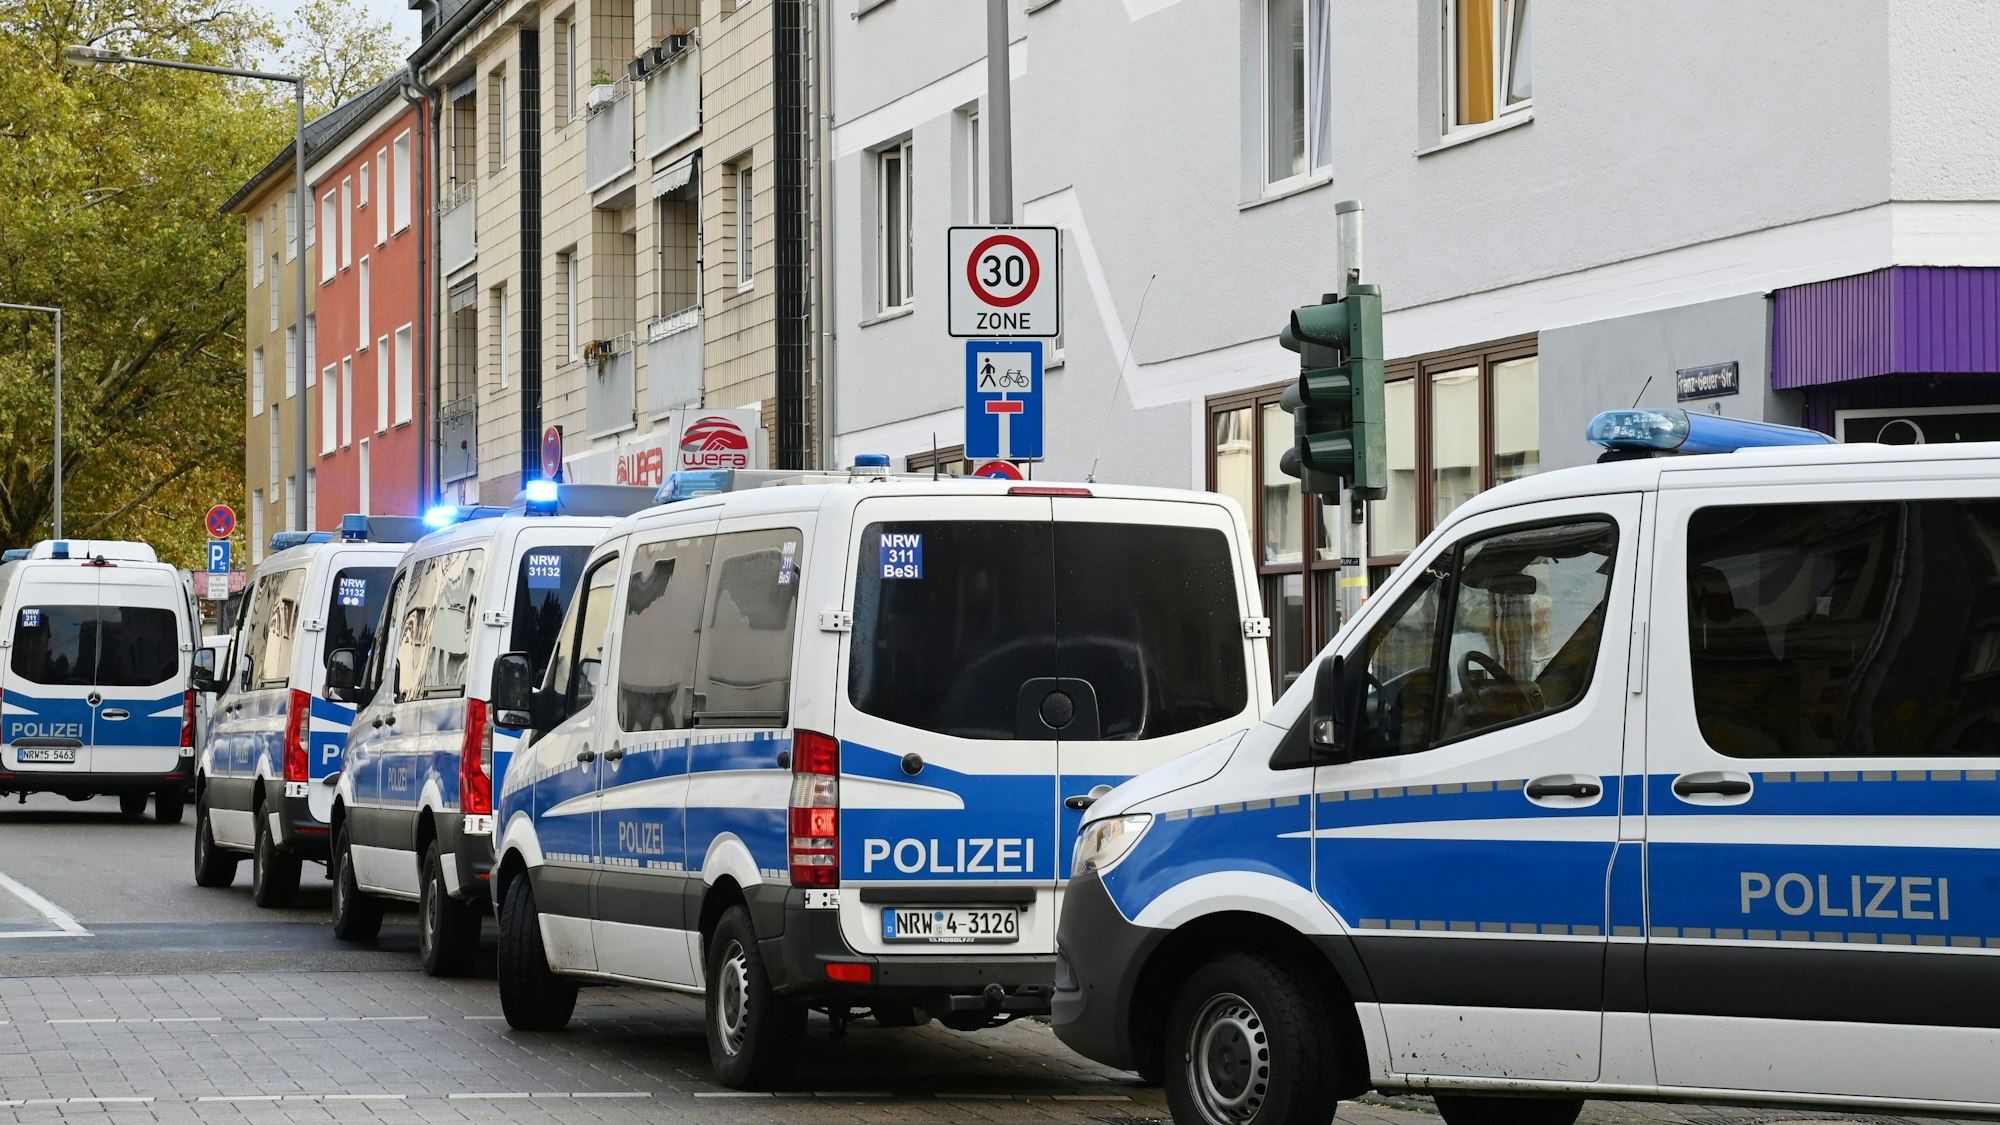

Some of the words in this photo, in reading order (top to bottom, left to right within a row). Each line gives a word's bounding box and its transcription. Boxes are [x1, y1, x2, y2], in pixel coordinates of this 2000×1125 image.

[982, 255, 1024, 287] 30
[976, 312, 1031, 329] ZONE
[782, 541, 797, 555] NRW
[881, 534, 920, 548] NRW
[211, 545, 224, 570] P
[530, 555, 560, 566] NRW
[782, 556, 793, 570] 311
[888, 549, 914, 563] 311
[529, 567, 560, 577] 31132
[778, 571, 791, 584] BeSi
[883, 564, 918, 578] BeSi
[340, 578, 366, 588] NRW
[339, 588, 365, 597] 31132
[12, 722, 83, 738] POLIZEI
[23, 750, 40, 759] NRW
[388, 767, 407, 791] POLIZEI
[619, 821, 664, 855] POLIZEI
[864, 838, 1034, 873] POLIZEI
[1740, 872, 1949, 921] POLIZEI
[896, 912, 933, 934] NRW
